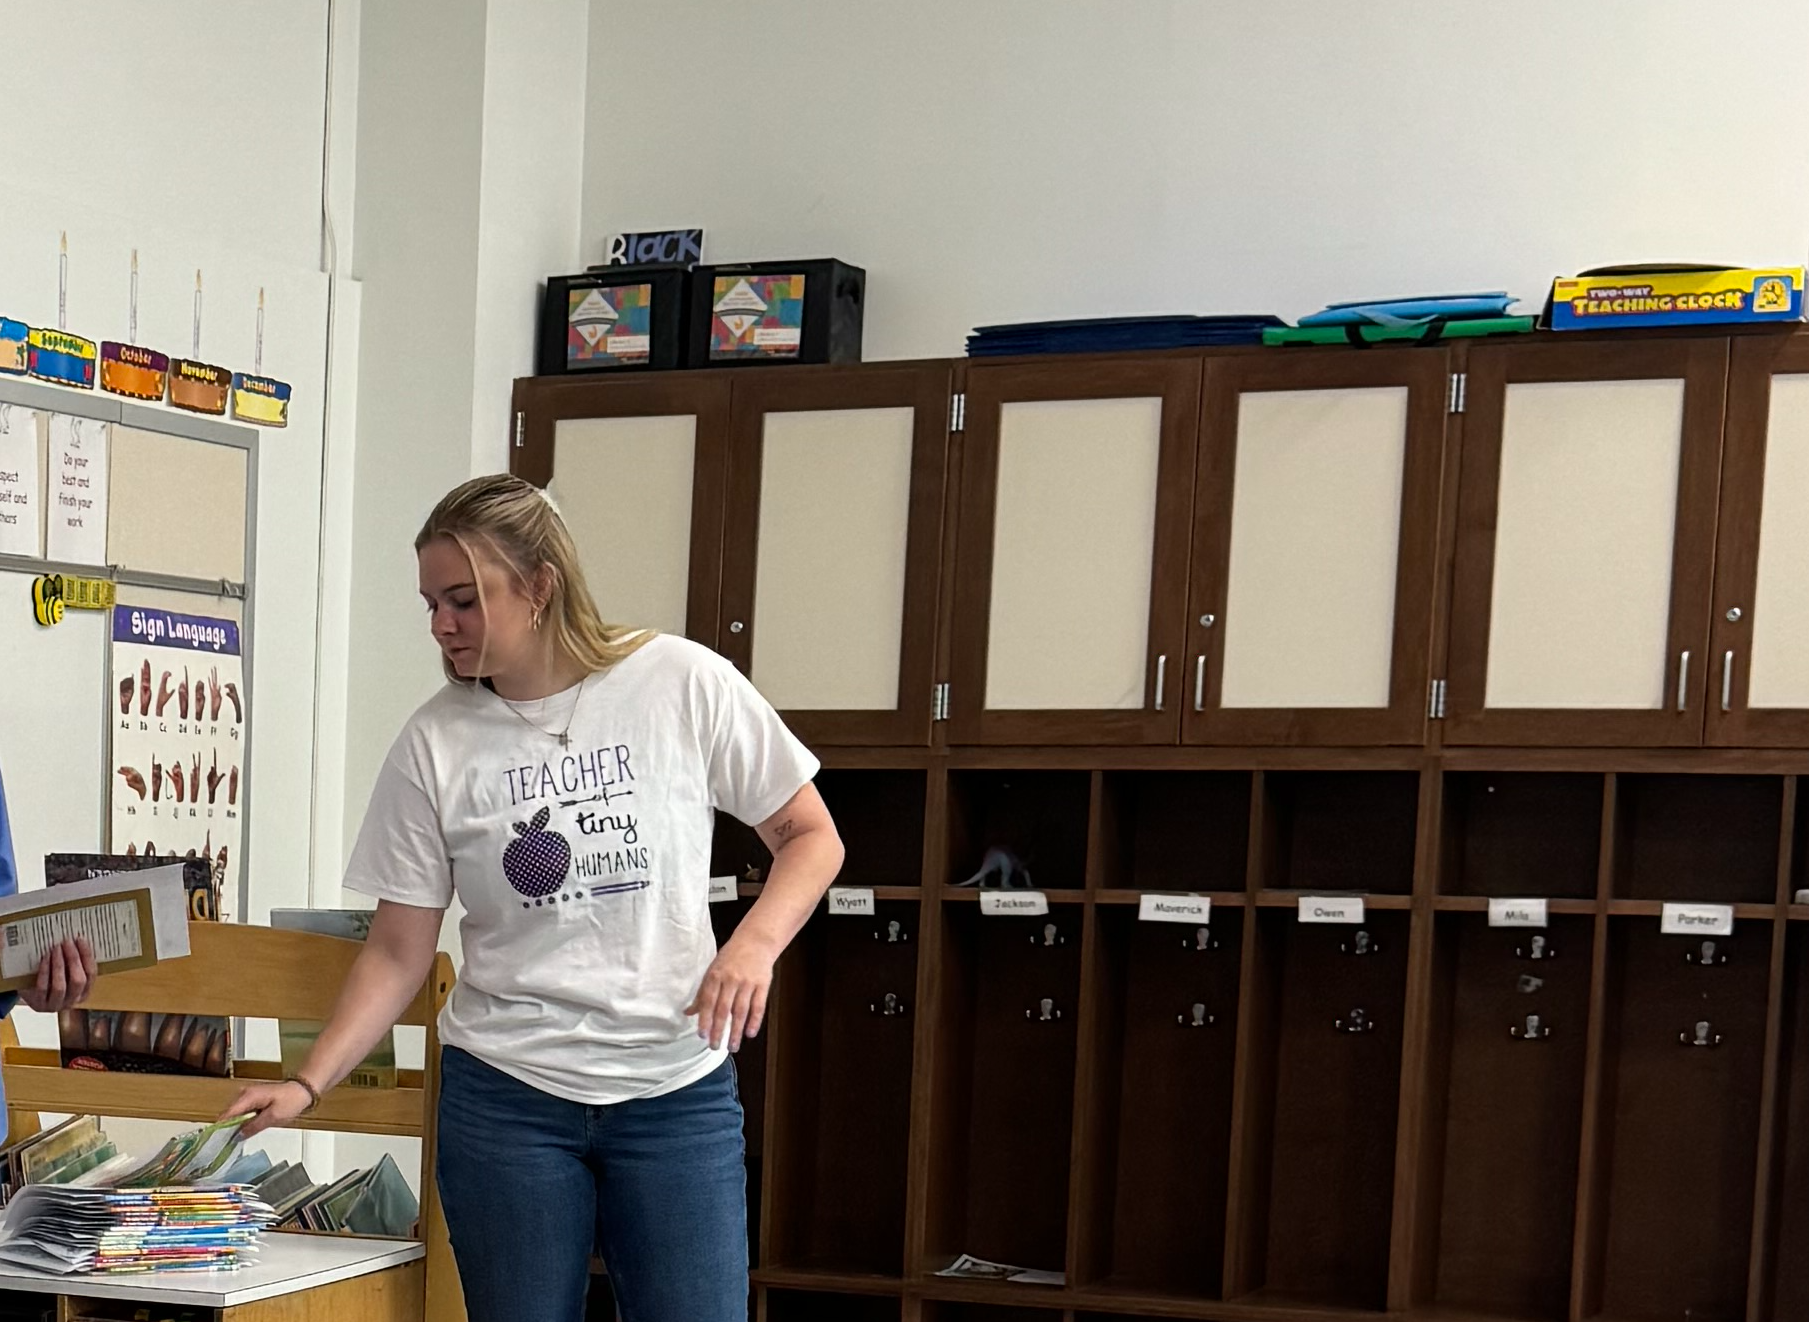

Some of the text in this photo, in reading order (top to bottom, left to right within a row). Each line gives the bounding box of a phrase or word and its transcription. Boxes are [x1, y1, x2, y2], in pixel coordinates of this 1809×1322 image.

[1573, 292, 1743, 315] TEACHING CLOCK
[181, 361, 219, 381] November
[131, 611, 226, 650] Sign Language
[503, 744, 635, 805] TEACHER
[575, 812, 637, 844] tiny
[574, 847, 648, 878] HUMANS
[836, 897, 867, 909] Wyatt
[1313, 907, 1344, 919] Owen
[1678, 913, 1718, 926] Parker
